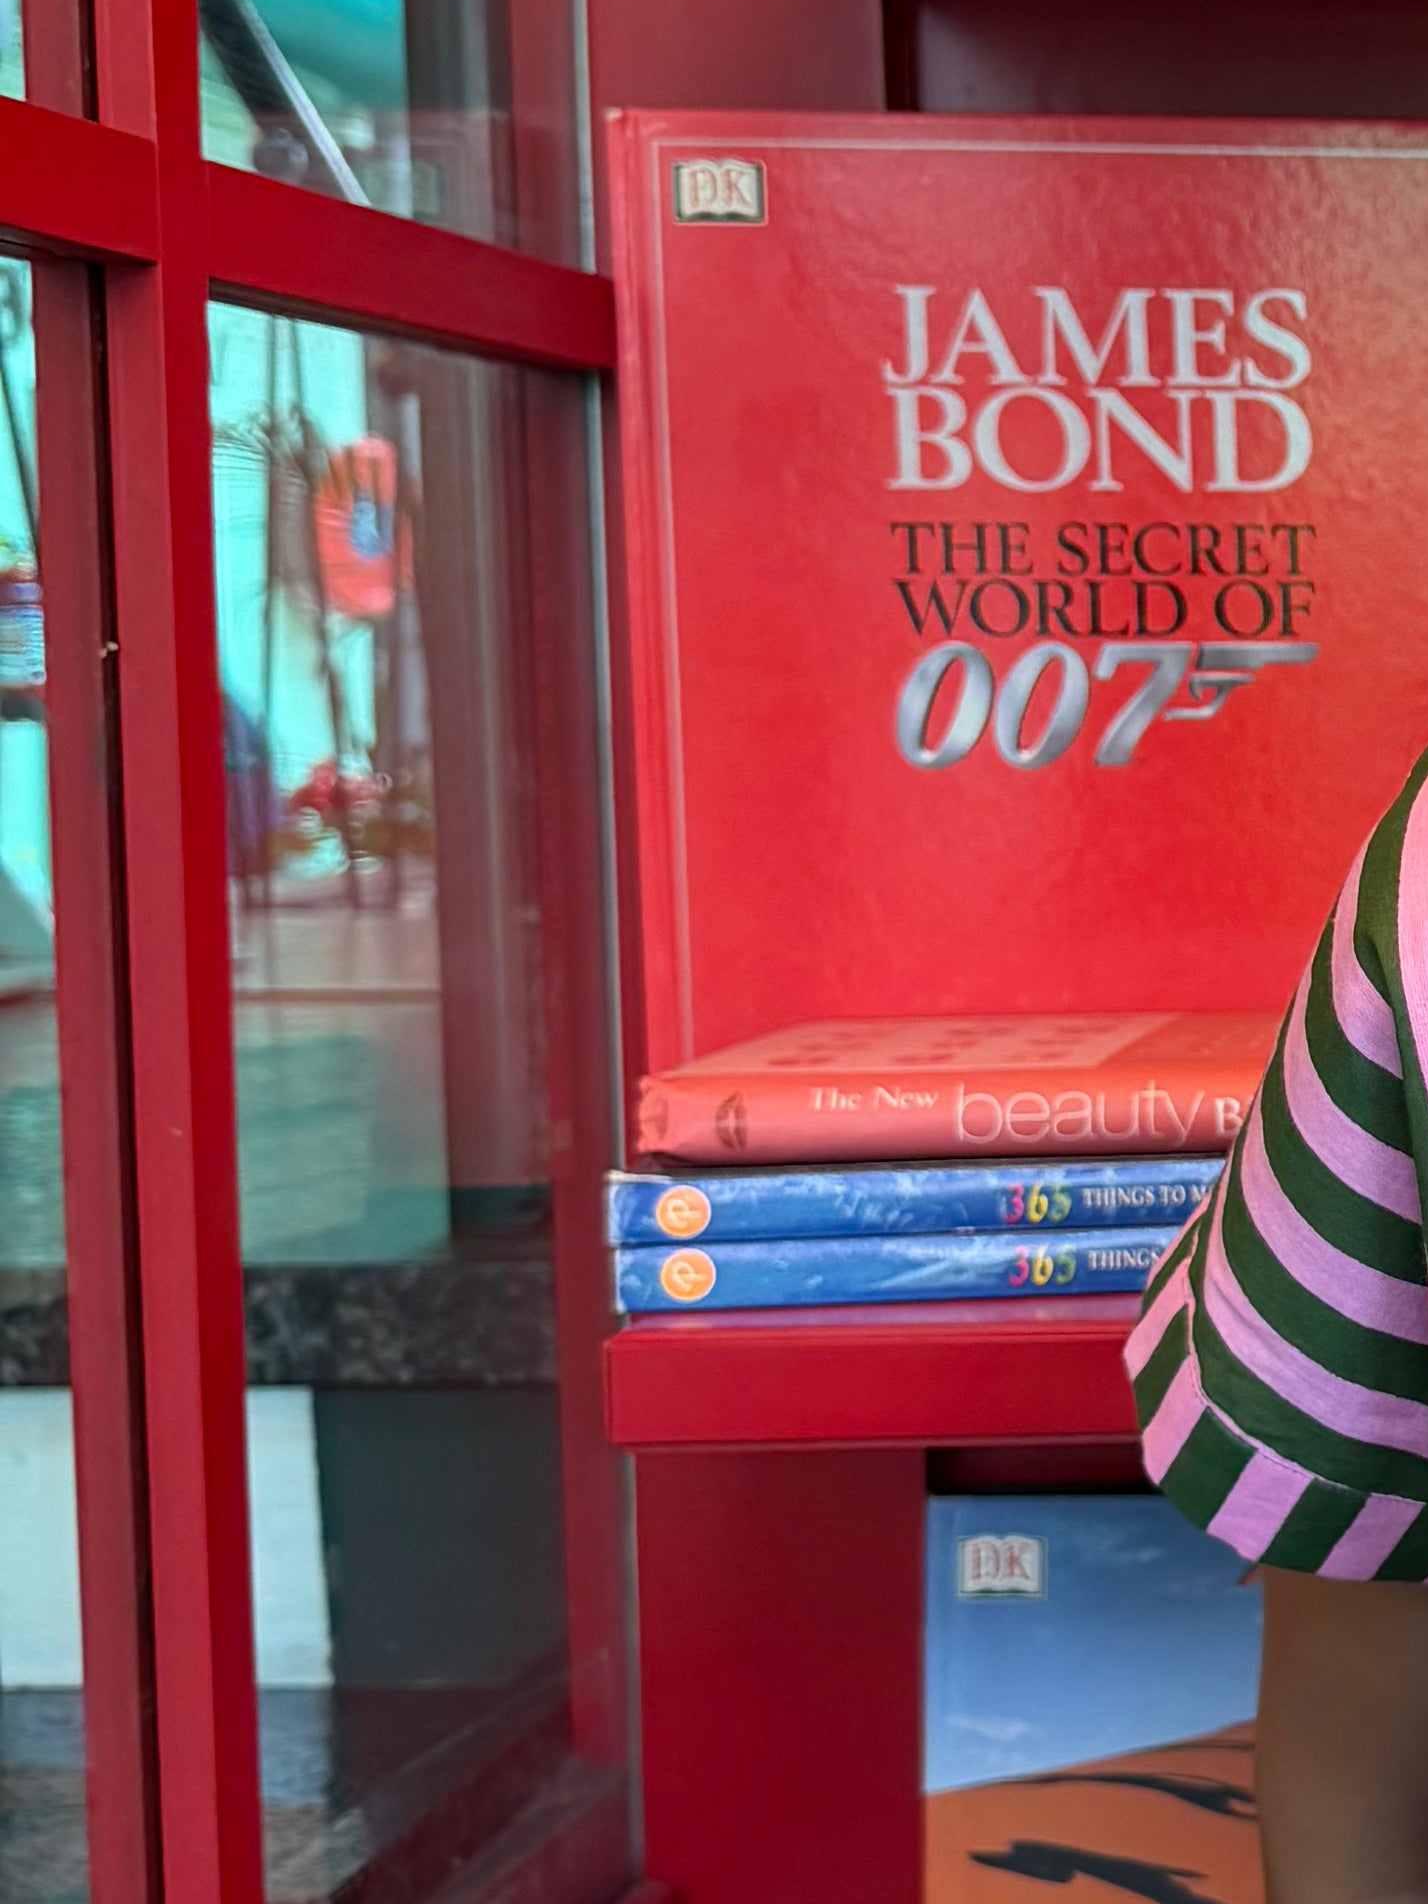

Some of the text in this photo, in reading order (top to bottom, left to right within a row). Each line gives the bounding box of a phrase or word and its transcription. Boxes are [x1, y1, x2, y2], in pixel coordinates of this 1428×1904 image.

[686, 167, 755, 212] DK
[882, 286, 1310, 390] JAMES
[886, 387, 1313, 494] BOND
[890, 521, 1317, 579] THE SECRET
[891, 579, 1318, 639] WORLD OF
[895, 641, 1200, 770] 007
[811, 1081, 1205, 1146] The New beauty
[1004, 1182, 1187, 1225] 365 THINGS TO
[1007, 1245, 1161, 1288] 365 THINGS
[969, 1541, 1032, 1582] DK
